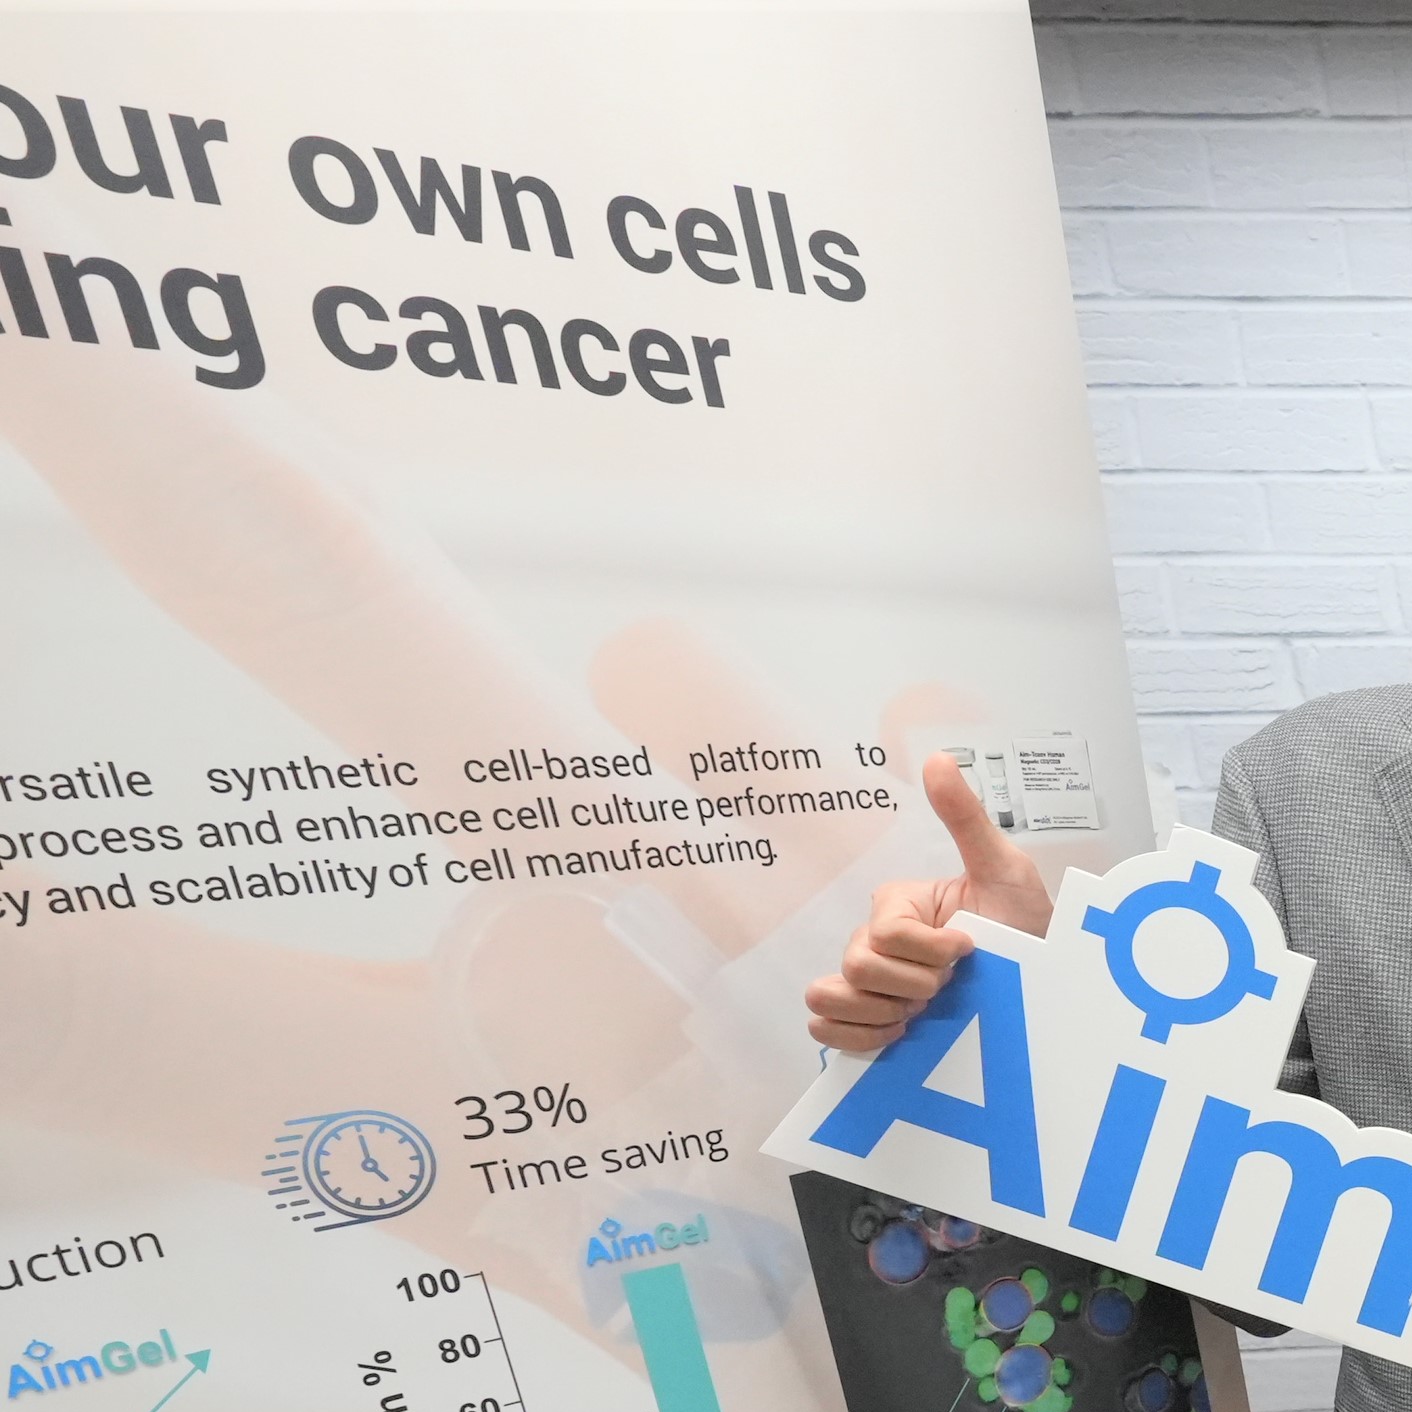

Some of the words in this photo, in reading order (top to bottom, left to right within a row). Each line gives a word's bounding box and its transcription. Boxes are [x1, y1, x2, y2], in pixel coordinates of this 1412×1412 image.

[287, 134, 573, 260] own
[606, 184, 868, 303] cells
[0, 207, 266, 389] ing
[312, 279, 731, 409] cancer
[207, 753, 418, 801] synthetic
[464, 746, 652, 783] cell-based
[690, 742, 821, 781] platform
[855, 743, 886, 766] to
[0, 825, 183, 869] process
[197, 810, 282, 848] and
[296, 806, 482, 842] enhance
[493, 797, 559, 831] cell
[571, 794, 689, 826] culture
[696, 787, 897, 826] performance,
[46, 873, 136, 914] and
[149, 859, 377, 905] scalability
[389, 853, 428, 887] of
[445, 848, 515, 883] cell
[526, 833, 777, 877] manufacturing.
[461, 1083, 587, 1140] 33%
[470, 1156, 588, 1193] Time
[601, 1129, 728, 1173] saving
[586, 1214, 709, 1267] AimGel
[396, 1269, 461, 1301] 100
[8, 1328, 179, 1399] AimGel
[358, 1350, 397, 1386] %
[439, 1334, 481, 1363] 80
